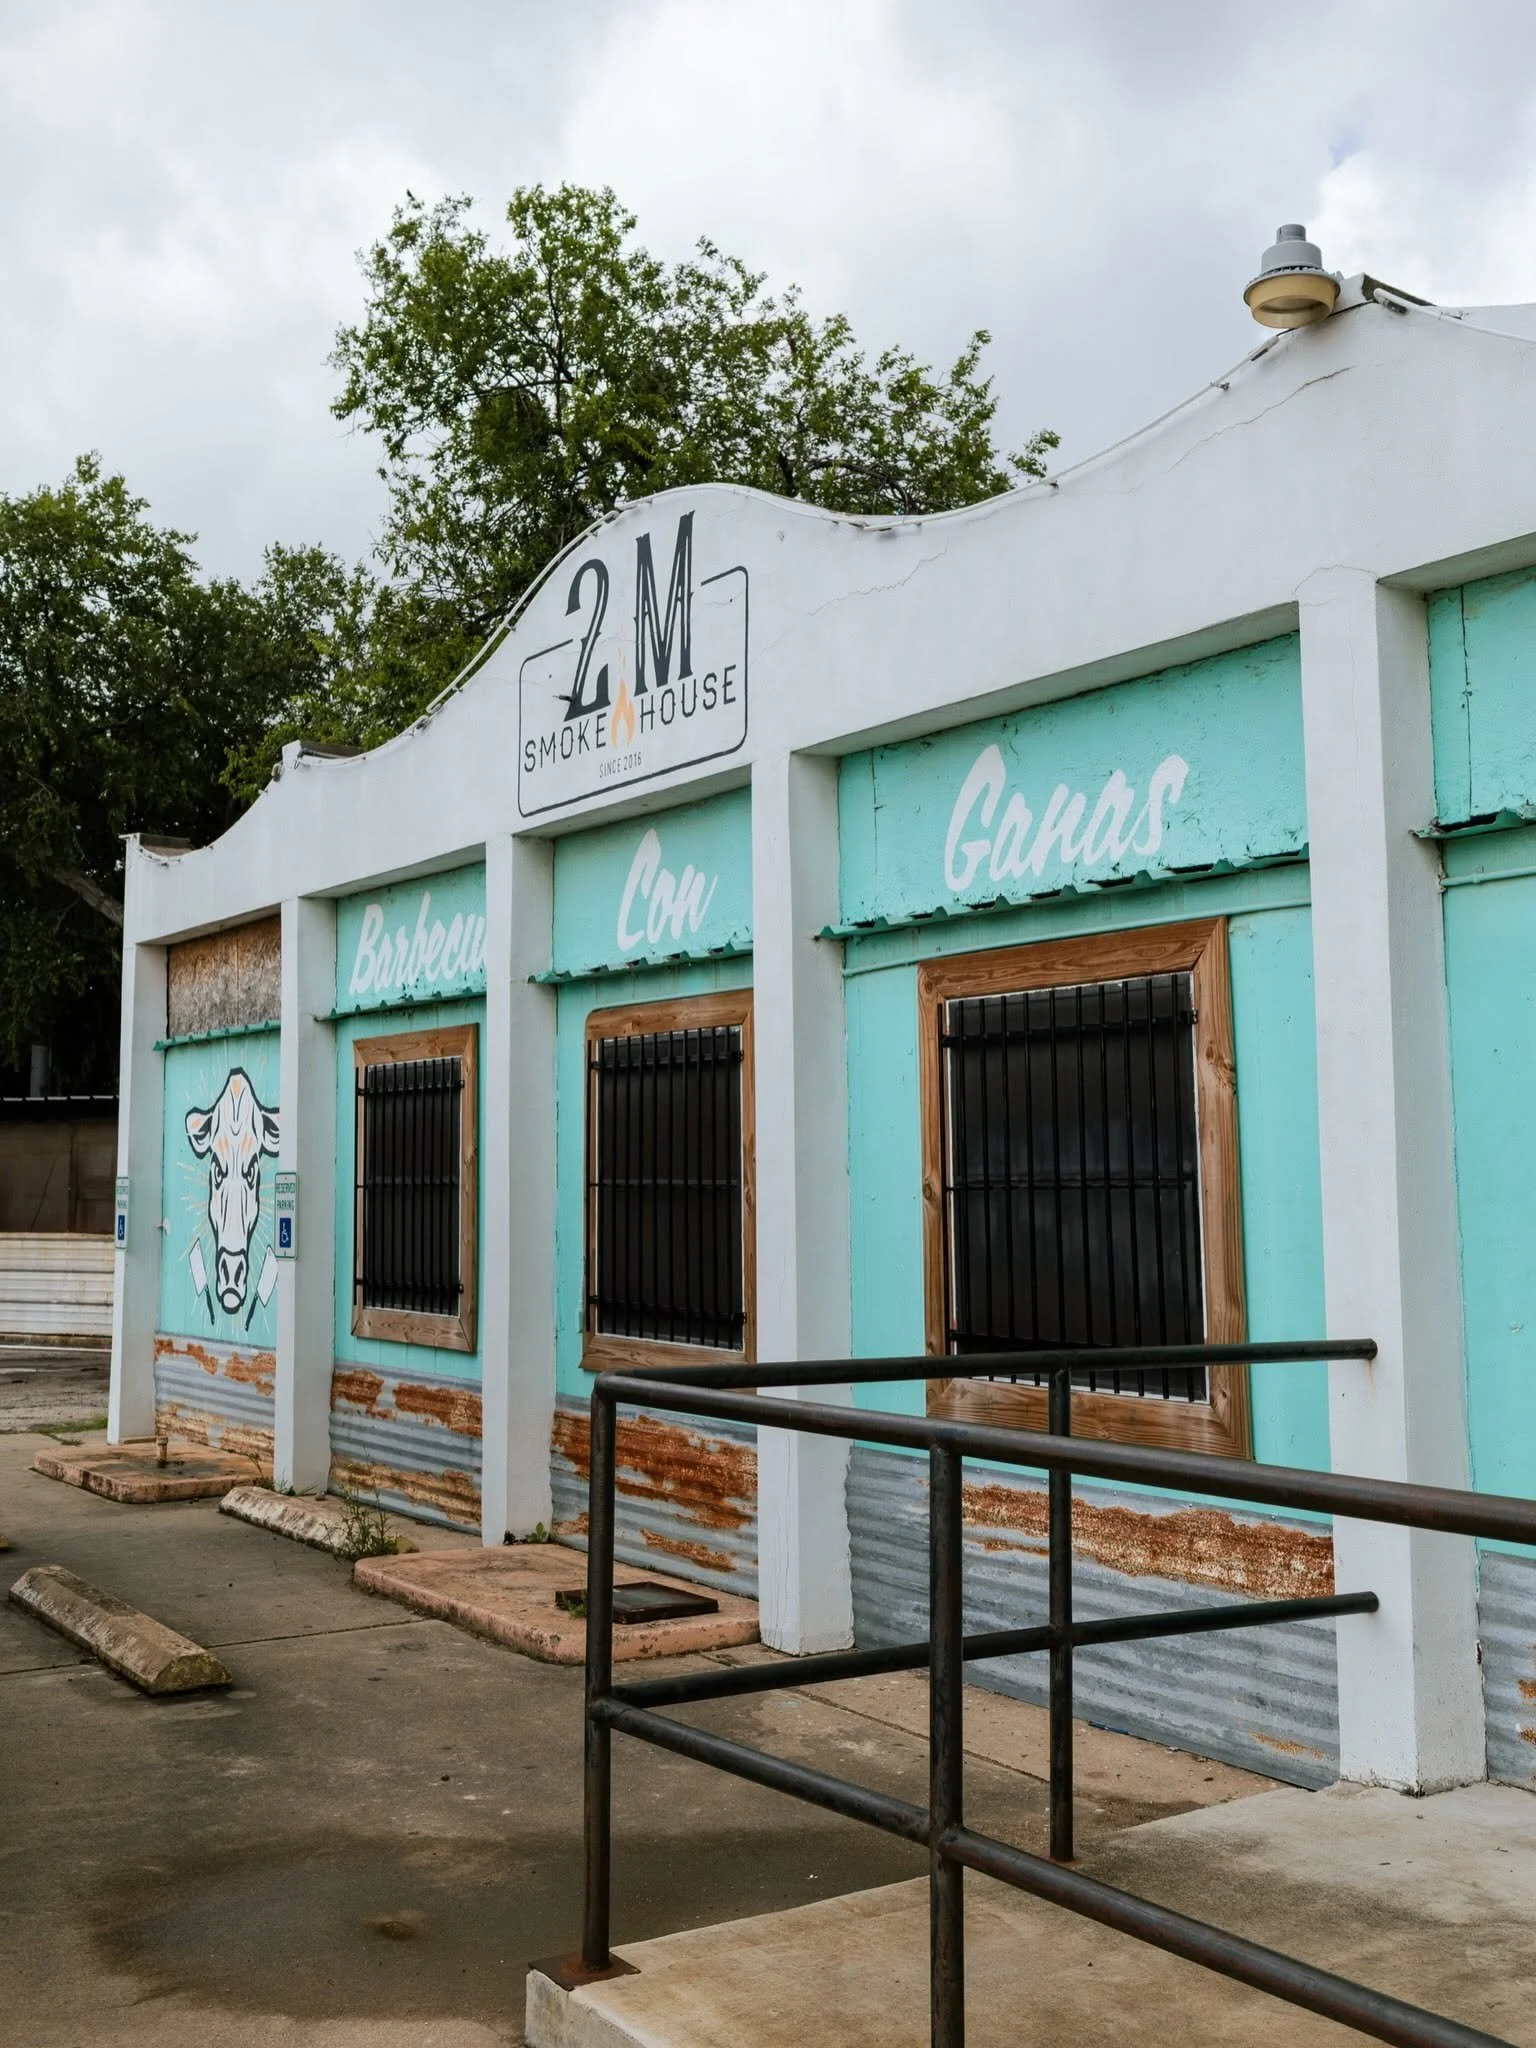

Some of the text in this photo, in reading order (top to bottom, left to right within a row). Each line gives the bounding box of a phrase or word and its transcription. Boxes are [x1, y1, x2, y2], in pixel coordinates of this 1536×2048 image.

[523, 664, 737, 773] SMOKE HOUSE
[599, 751, 642, 778] SINCE 2016
[349, 743, 1190, 996] Barbecu Con Ganas
